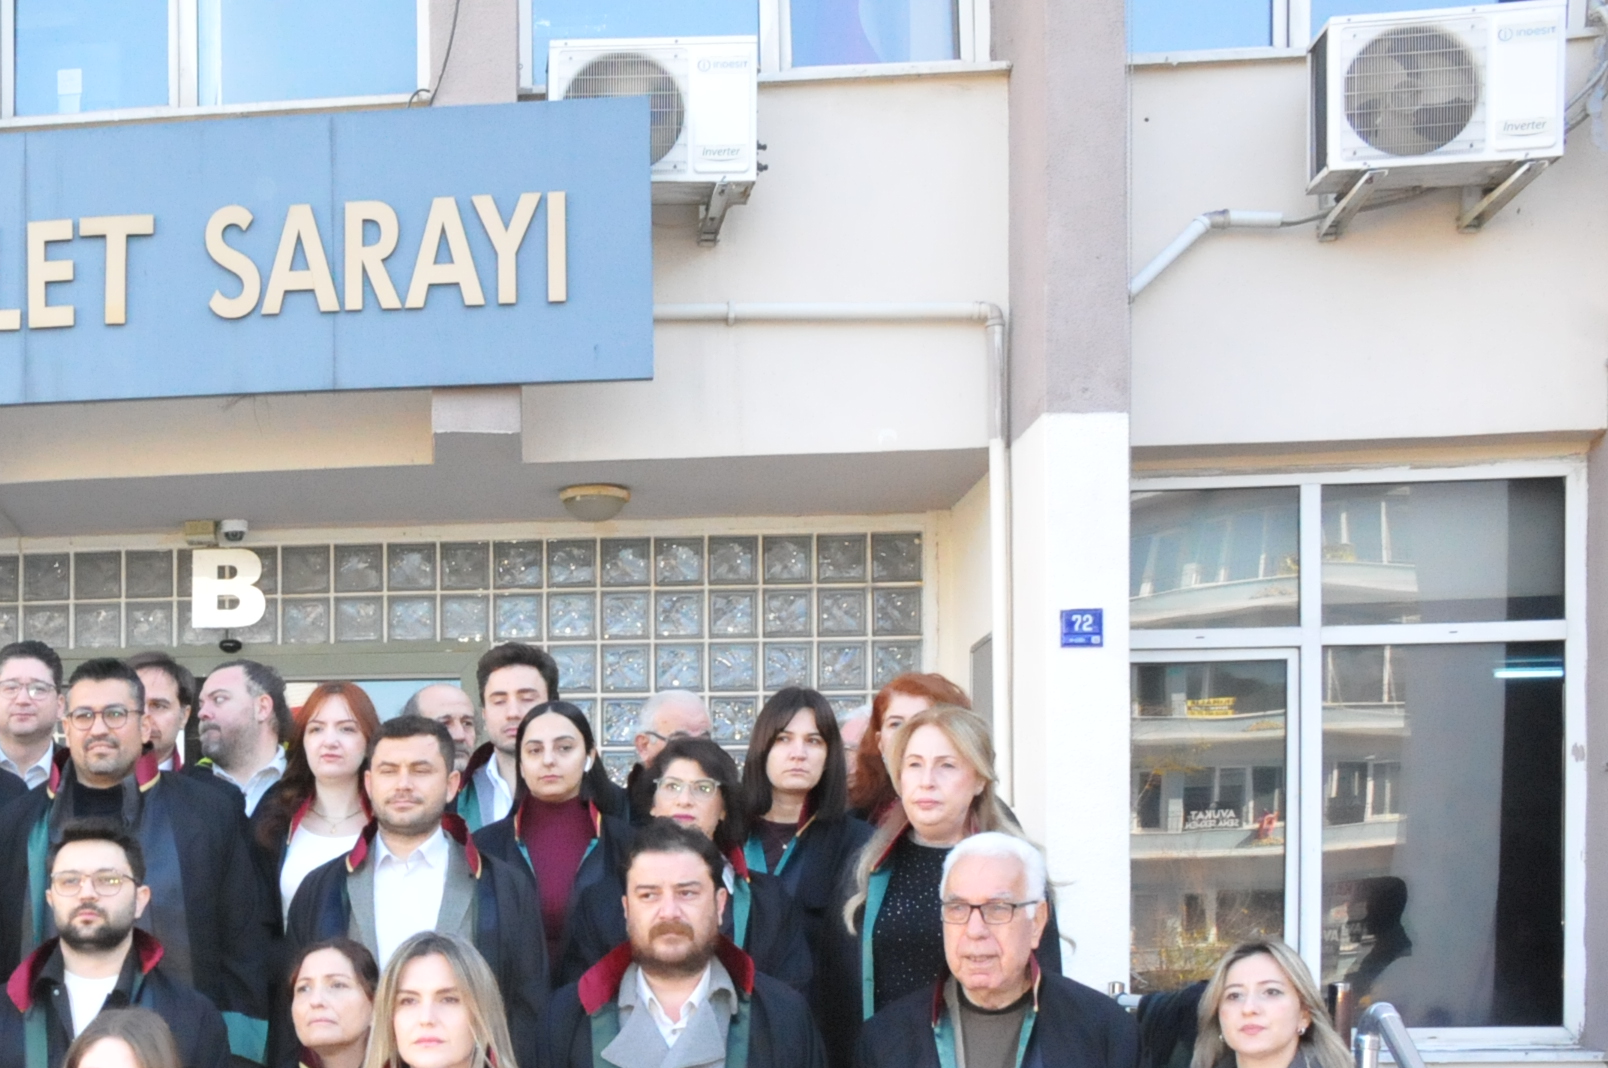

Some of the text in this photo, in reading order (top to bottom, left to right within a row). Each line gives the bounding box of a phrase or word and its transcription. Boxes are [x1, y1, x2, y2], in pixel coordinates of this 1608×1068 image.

[1502, 121, 1547, 131] Inverter
[701, 147, 741, 156] Inverter
[204, 191, 566, 319] SARAYI
[191, 549, 266, 628] B
[1071, 614, 1093, 631] 72
